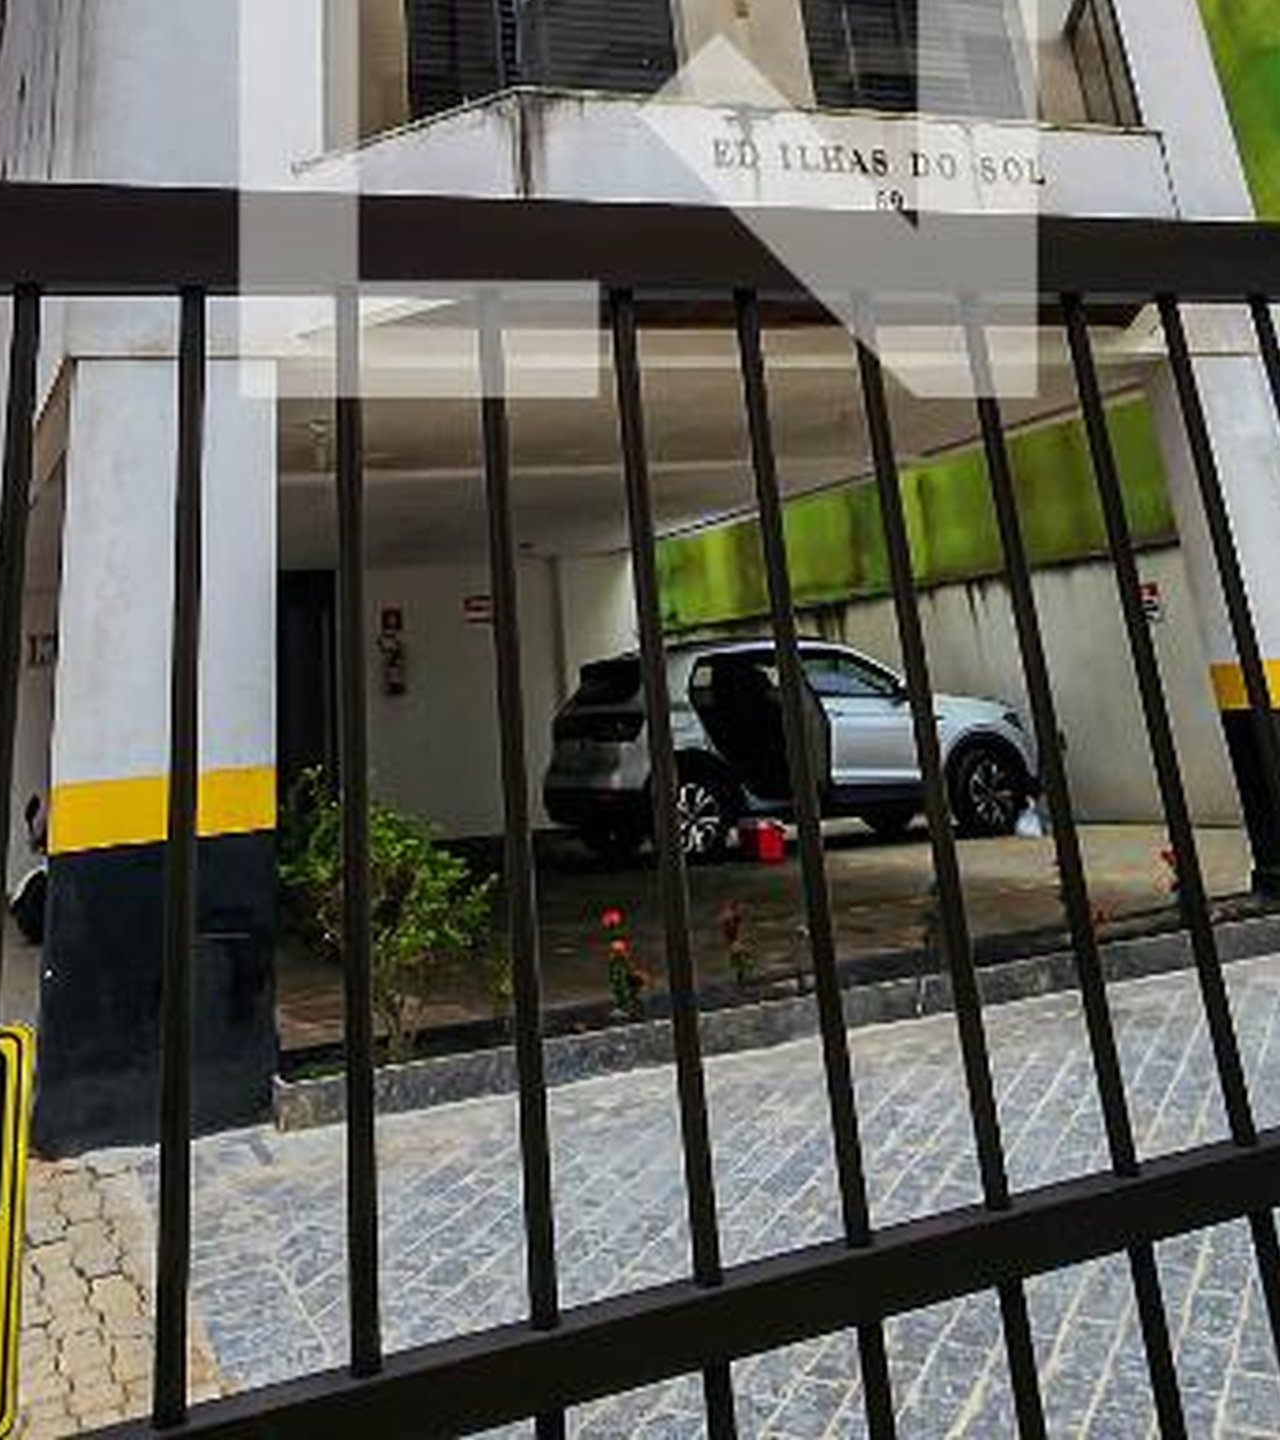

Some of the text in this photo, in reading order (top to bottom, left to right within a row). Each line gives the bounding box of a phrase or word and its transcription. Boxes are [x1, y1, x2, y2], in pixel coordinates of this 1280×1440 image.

[779, 143, 889, 177] ILHAS
[910, 151, 956, 180] DO
[980, 154, 1045, 185] SOL
